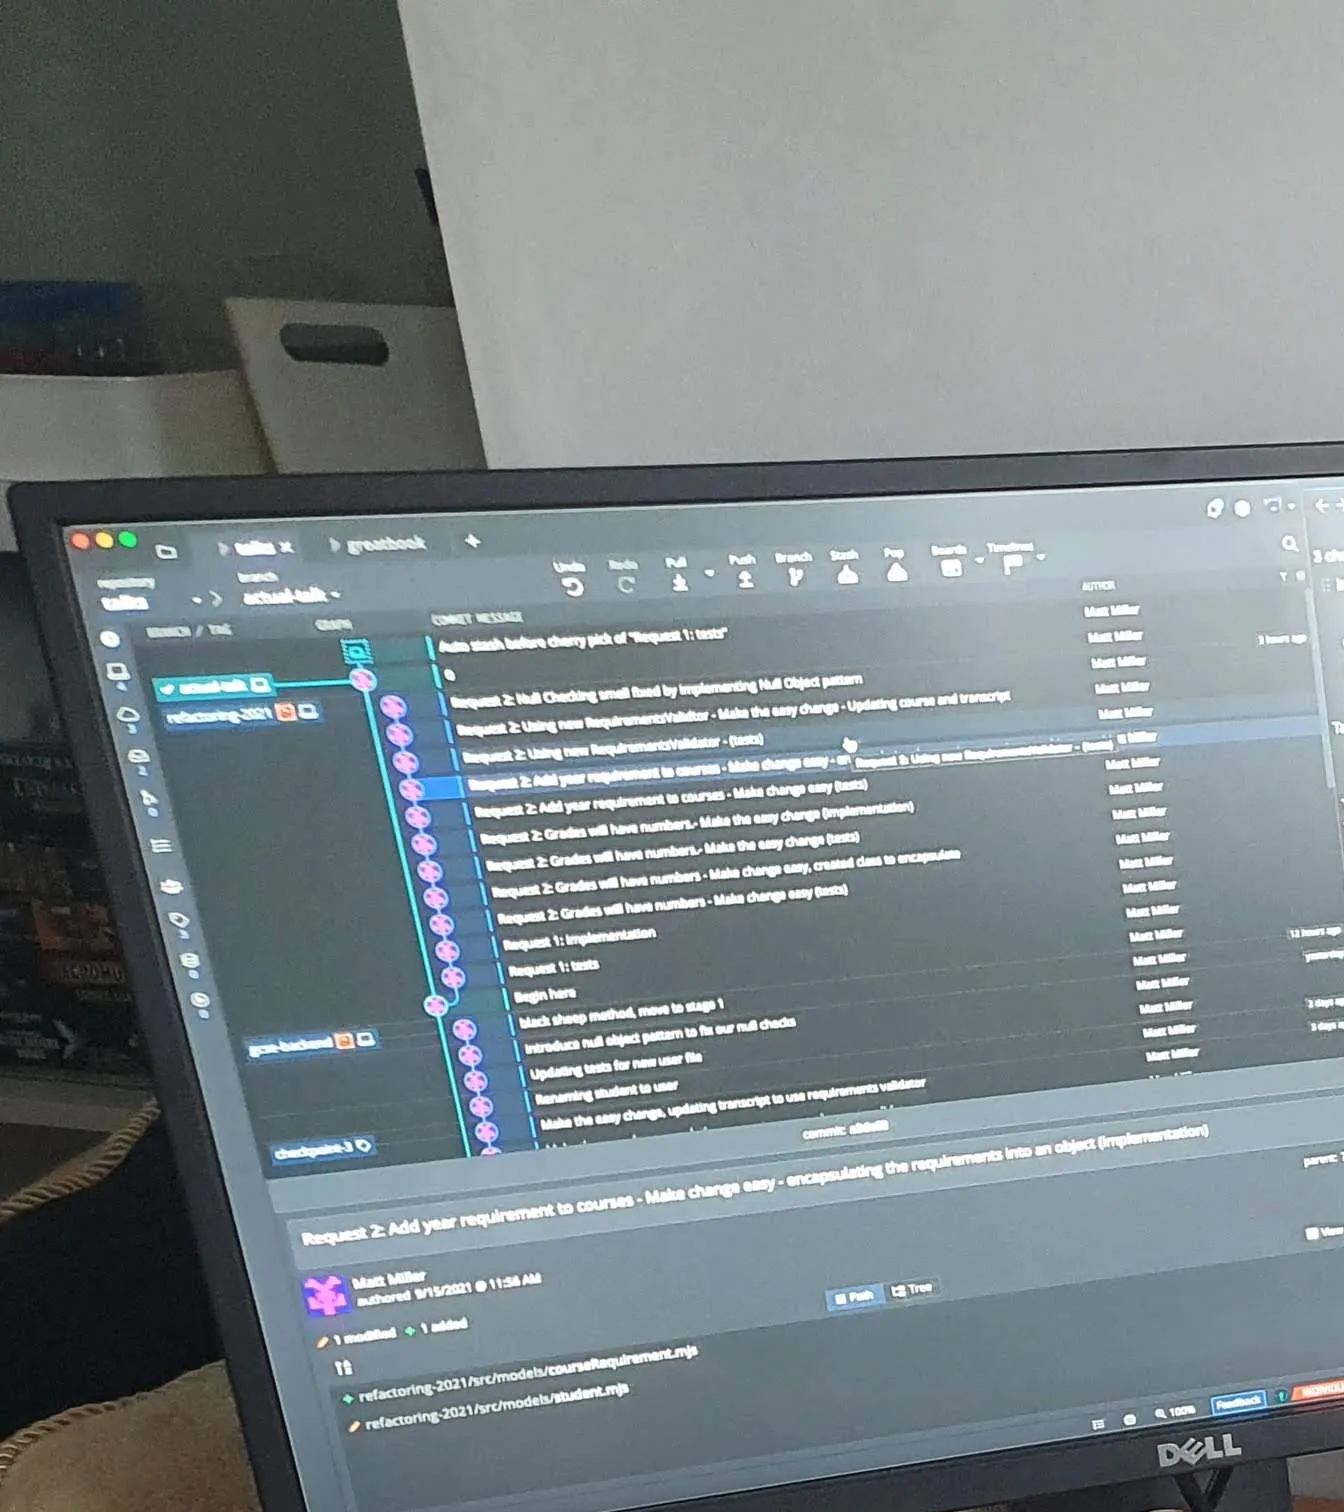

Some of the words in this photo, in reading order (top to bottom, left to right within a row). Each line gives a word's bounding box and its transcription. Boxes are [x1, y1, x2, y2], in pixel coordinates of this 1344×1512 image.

[347, 534, 428, 554] greatbook
[503, 936, 550, 951] Request
[553, 936, 564, 947] 1:
[566, 926, 657, 947] implementation
[531, 1064, 582, 1081] Updating
[584, 1061, 611, 1075] tests
[614, 1058, 629, 1071] for
[631, 1058, 654, 1069] new
[657, 1054, 682, 1068] user
[685, 1050, 702, 1064] file
[536, 1088, 593, 1106] Renaming
[594, 1084, 636, 1100] student
[639, 1082, 651, 1094] to
[653, 1079, 679, 1093] user
[301, 1223, 368, 1247] Request
[388, 1220, 420, 1235] Add
[424, 1216, 456, 1236] year
[460, 1203, 555, 1228] requirement
[558, 1201, 574, 1216] to
[577, 1193, 634, 1211] courses
[644, 1187, 686, 1204] Make
[688, 1179, 741, 1201] change
[742, 1176, 776, 1195] easy
[787, 1156, 884, 1185] encapsulating
[885, 1157, 908, 1174] the
[911, 1147, 1003, 1174] requirements
[1005, 1142, 1032, 1159] into
[1035, 1143, 1053, 1157] an
[1056, 1135, 1096, 1156] object
[1098, 1122, 1210, 1150] (implementation)
[352, 1273, 384, 1290] Matt
[388, 1268, 427, 1286] Miller
[357, 1289, 411, 1308] authored
[415, 1279, 473, 1301] 9/15/2021
[358, 1343, 699, 1403] refactoring-2021/src/models/courseRequirement.mjs
[365, 1381, 630, 1431] refactoring-2021/src/models/student.mjs
[1215, 1393, 1261, 1411] Feedback
[1156, 1433, 1243, 1468] DELL
